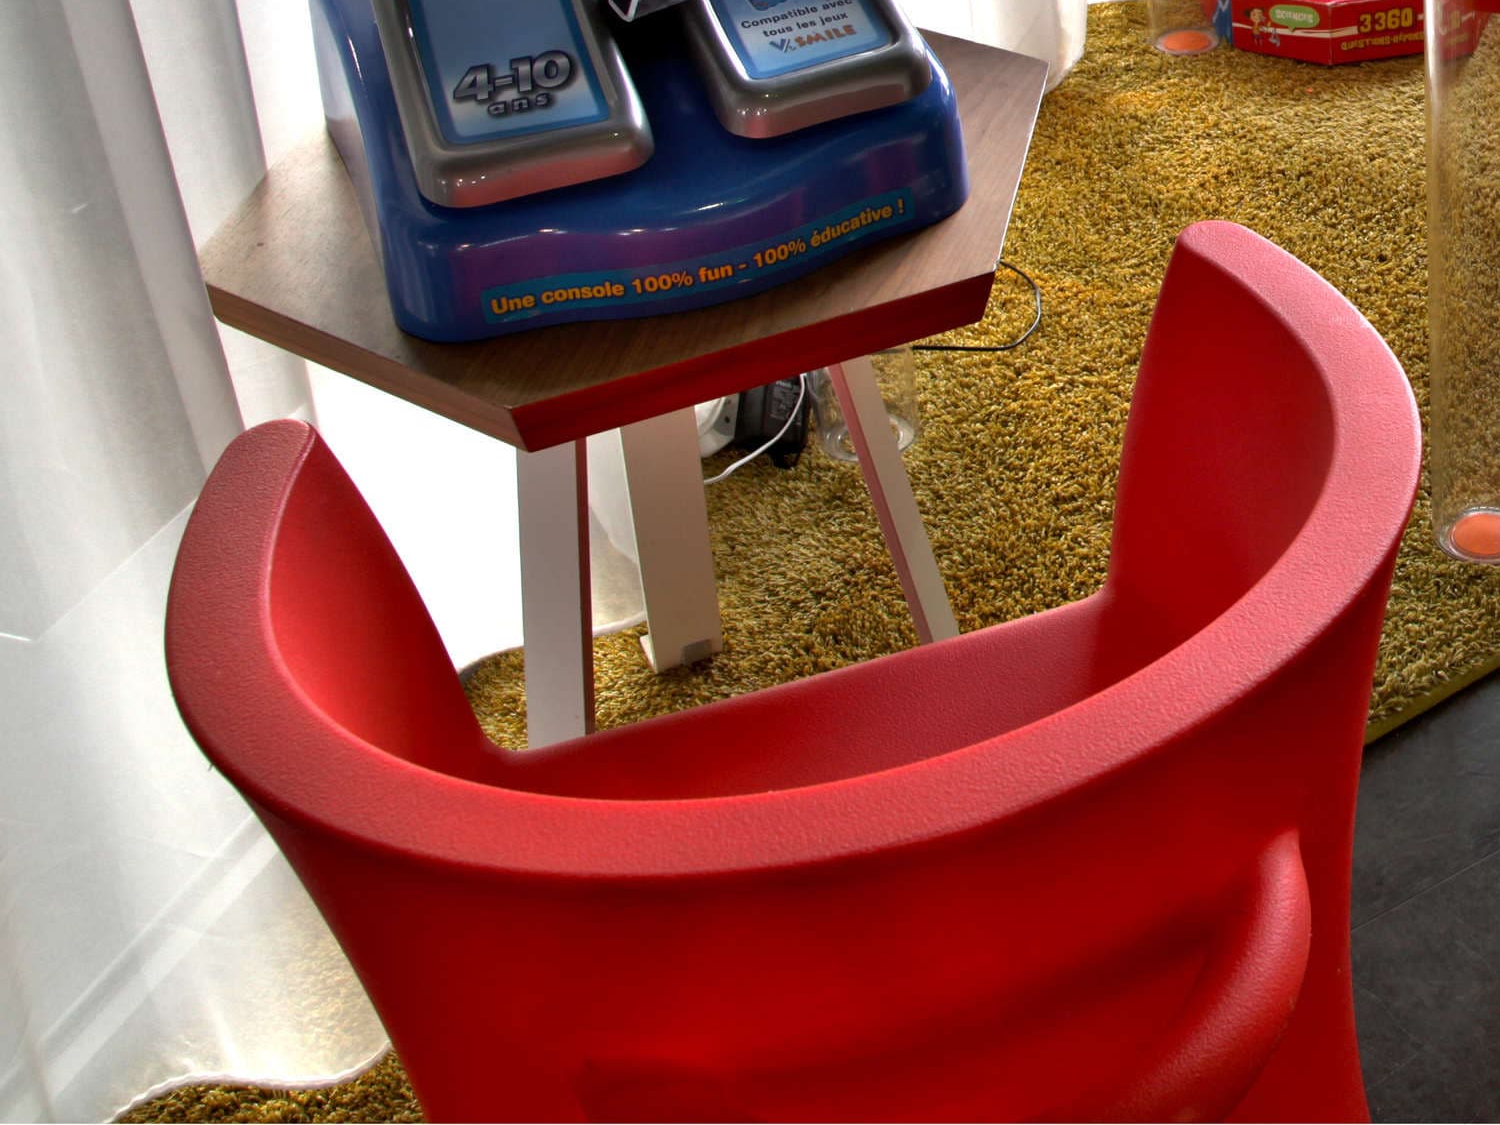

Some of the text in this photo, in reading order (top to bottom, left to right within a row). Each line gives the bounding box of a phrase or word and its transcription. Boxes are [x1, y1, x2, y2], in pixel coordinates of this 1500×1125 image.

[740, 5, 819, 29] Compatible
[762, 11, 849, 38] tous les jeux
[453, 49, 574, 101] 4-10
[487, 92, 553, 116] ans
[490, 293, 537, 315] Une
[540, 280, 626, 305] console
[631, 270, 694, 295] 100%
[698, 262, 734, 284] fun
[753, 238, 806, 269] 100%
[809, 203, 893, 248] éducative
[897, 198, 905, 214] !
